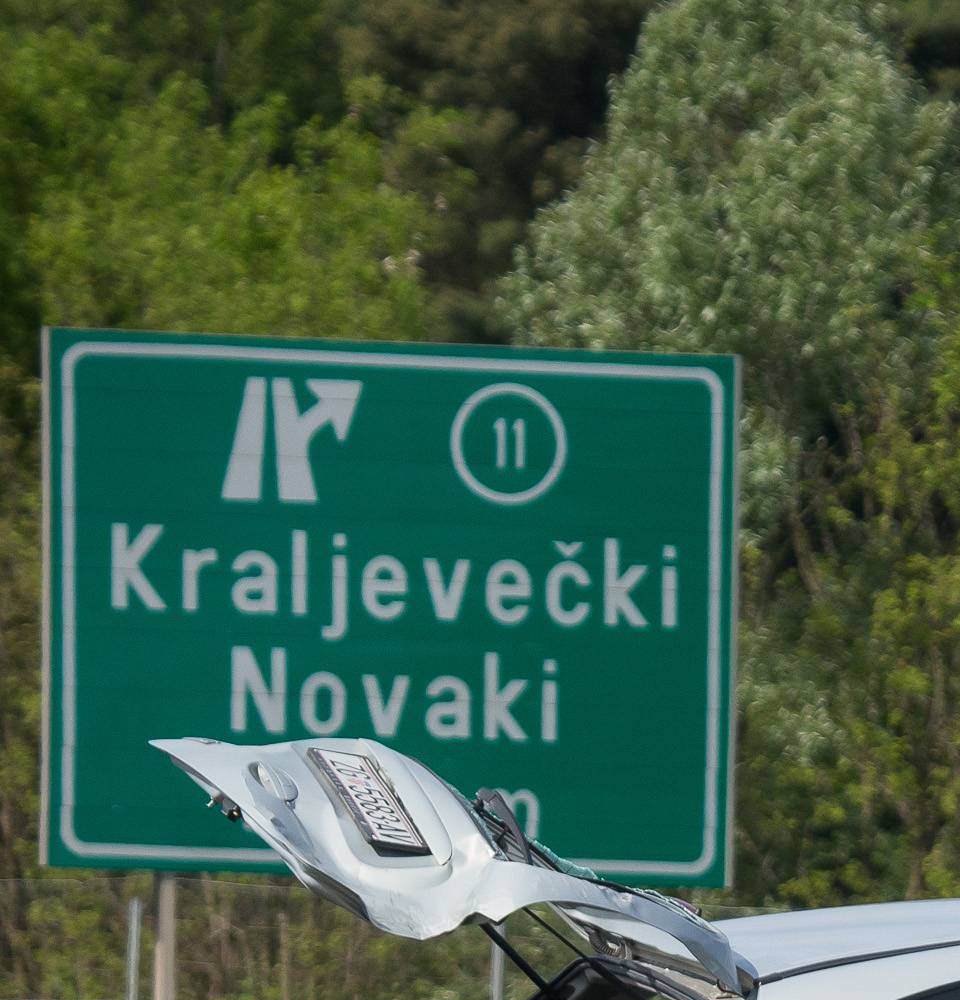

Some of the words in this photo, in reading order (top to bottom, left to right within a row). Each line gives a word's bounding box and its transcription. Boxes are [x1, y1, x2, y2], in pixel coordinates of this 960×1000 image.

[495, 417, 526, 469] 11
[110, 522, 679, 641] Kraljevečki
[229, 645, 560, 743] Novaki
